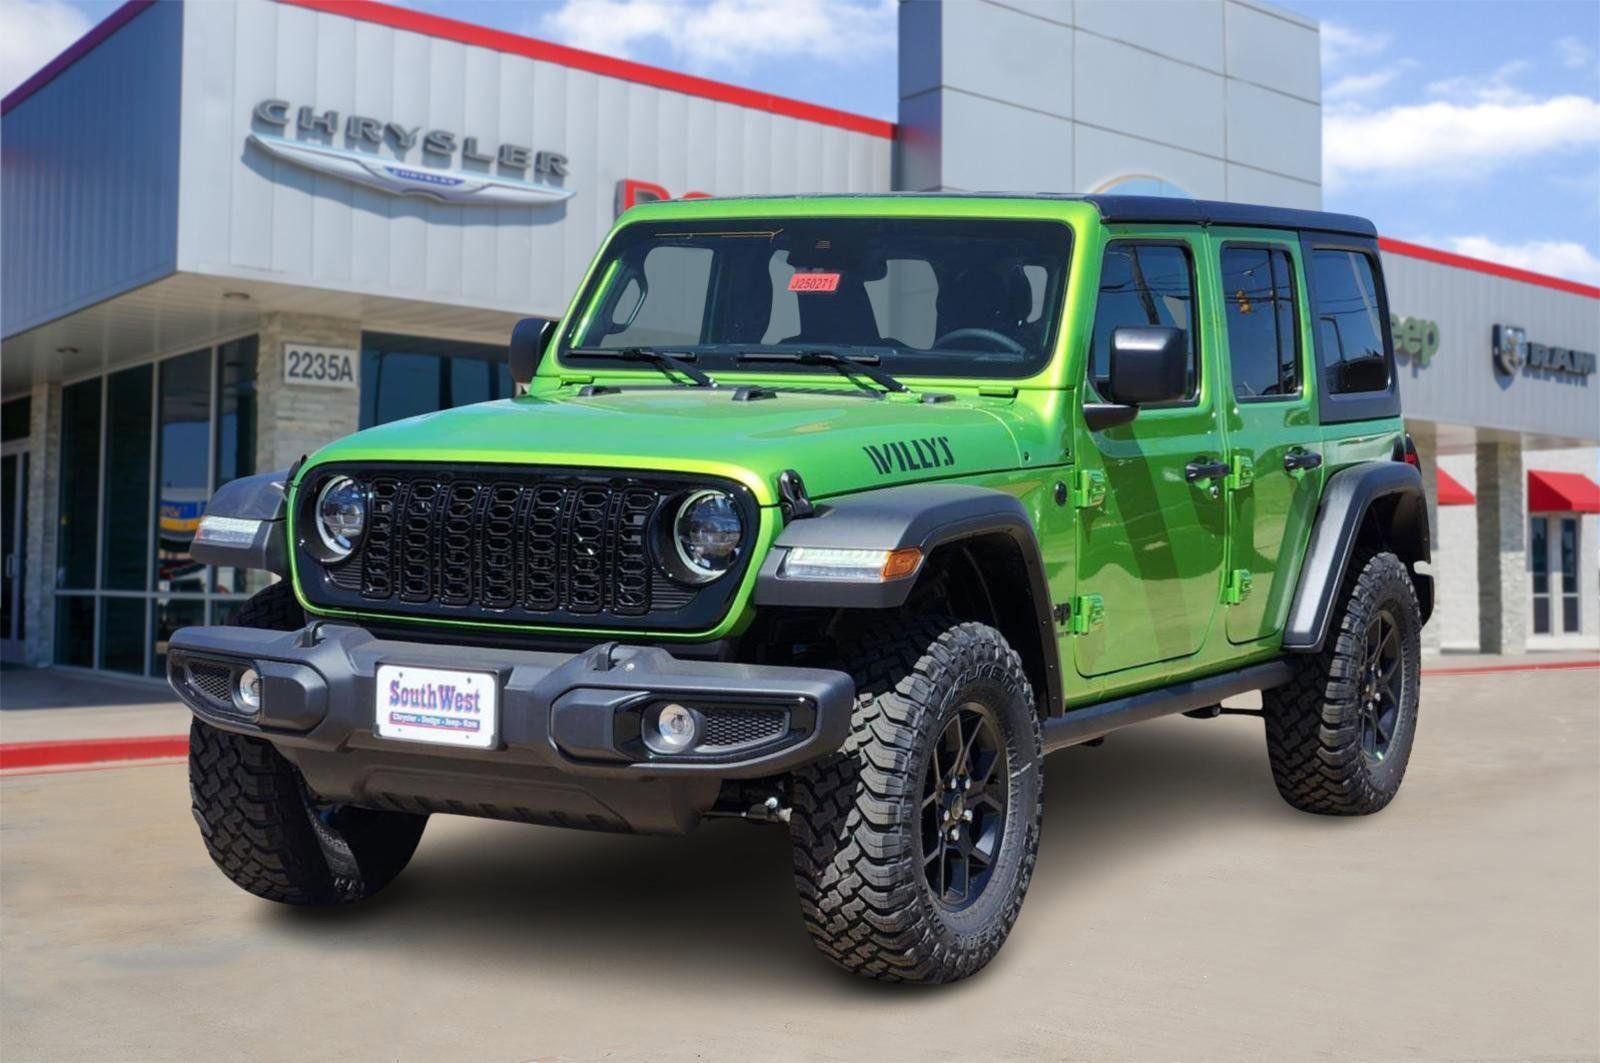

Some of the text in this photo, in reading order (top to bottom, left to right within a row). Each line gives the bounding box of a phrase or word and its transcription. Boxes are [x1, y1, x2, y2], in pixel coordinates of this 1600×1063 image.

[251, 98, 570, 177] CHRYSLER
[1390, 313, 1440, 365] eep
[288, 350, 354, 382] 2235A
[1526, 342, 1596, 376] RAM
[862, 435, 955, 475] WILLYS
[390, 679, 481, 713] SouthWest
